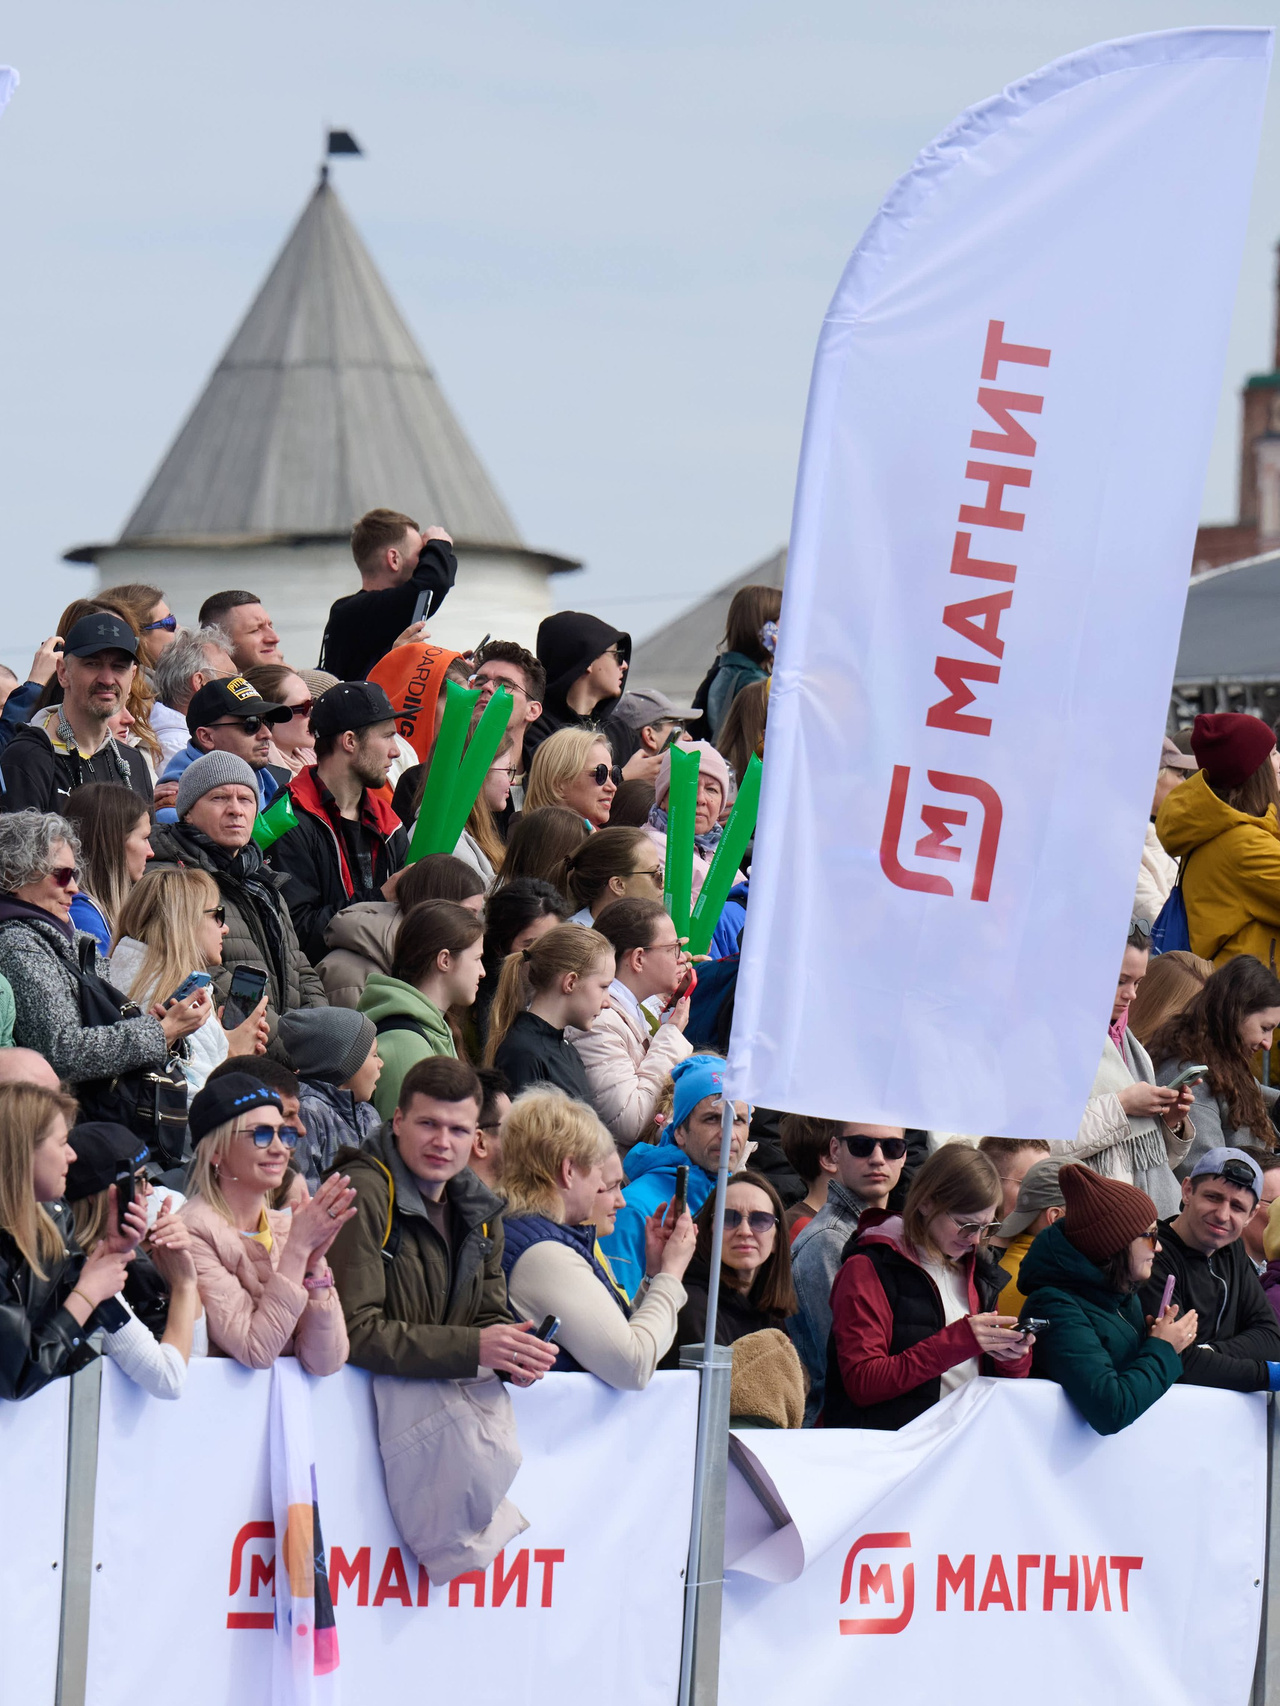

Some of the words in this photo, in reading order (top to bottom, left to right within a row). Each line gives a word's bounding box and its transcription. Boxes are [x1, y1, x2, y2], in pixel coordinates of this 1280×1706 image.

[926, 320, 1051, 736] МАГНИТ
[400, 646, 443, 738] OARDING
[935, 1554, 1144, 1612] МАГНИТ
